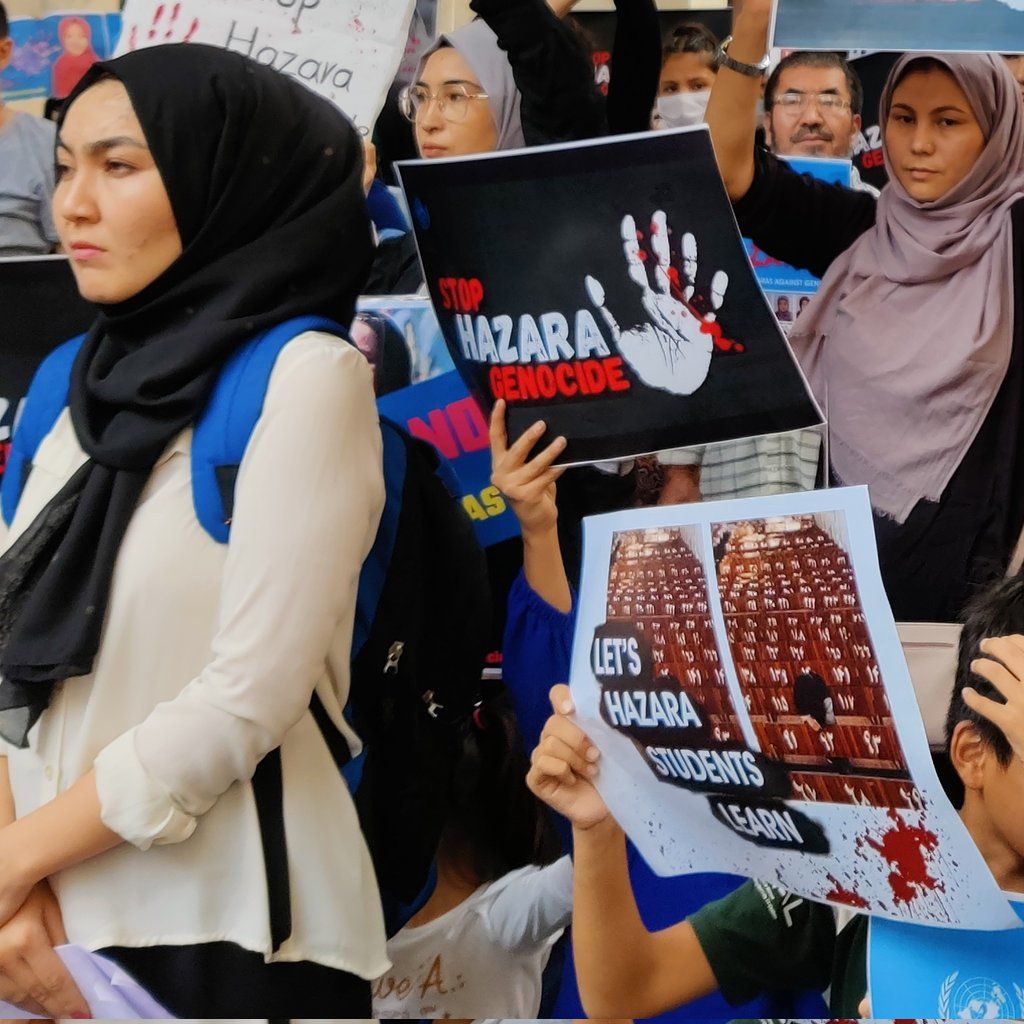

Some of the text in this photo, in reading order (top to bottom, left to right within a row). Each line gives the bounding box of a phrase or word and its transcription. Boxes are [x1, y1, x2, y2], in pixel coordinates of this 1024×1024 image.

[225, 20, 354, 93] Hazara
[438, 277, 484, 312] STOP
[456, 308, 610, 364] HAZARA
[489, 357, 630, 402] GENOCIDE
[593, 636, 642, 677] LET'S
[604, 690, 702, 728] HAZARA
[646, 745, 764, 789] STUDENTS
[719, 804, 804, 846] LEARN
